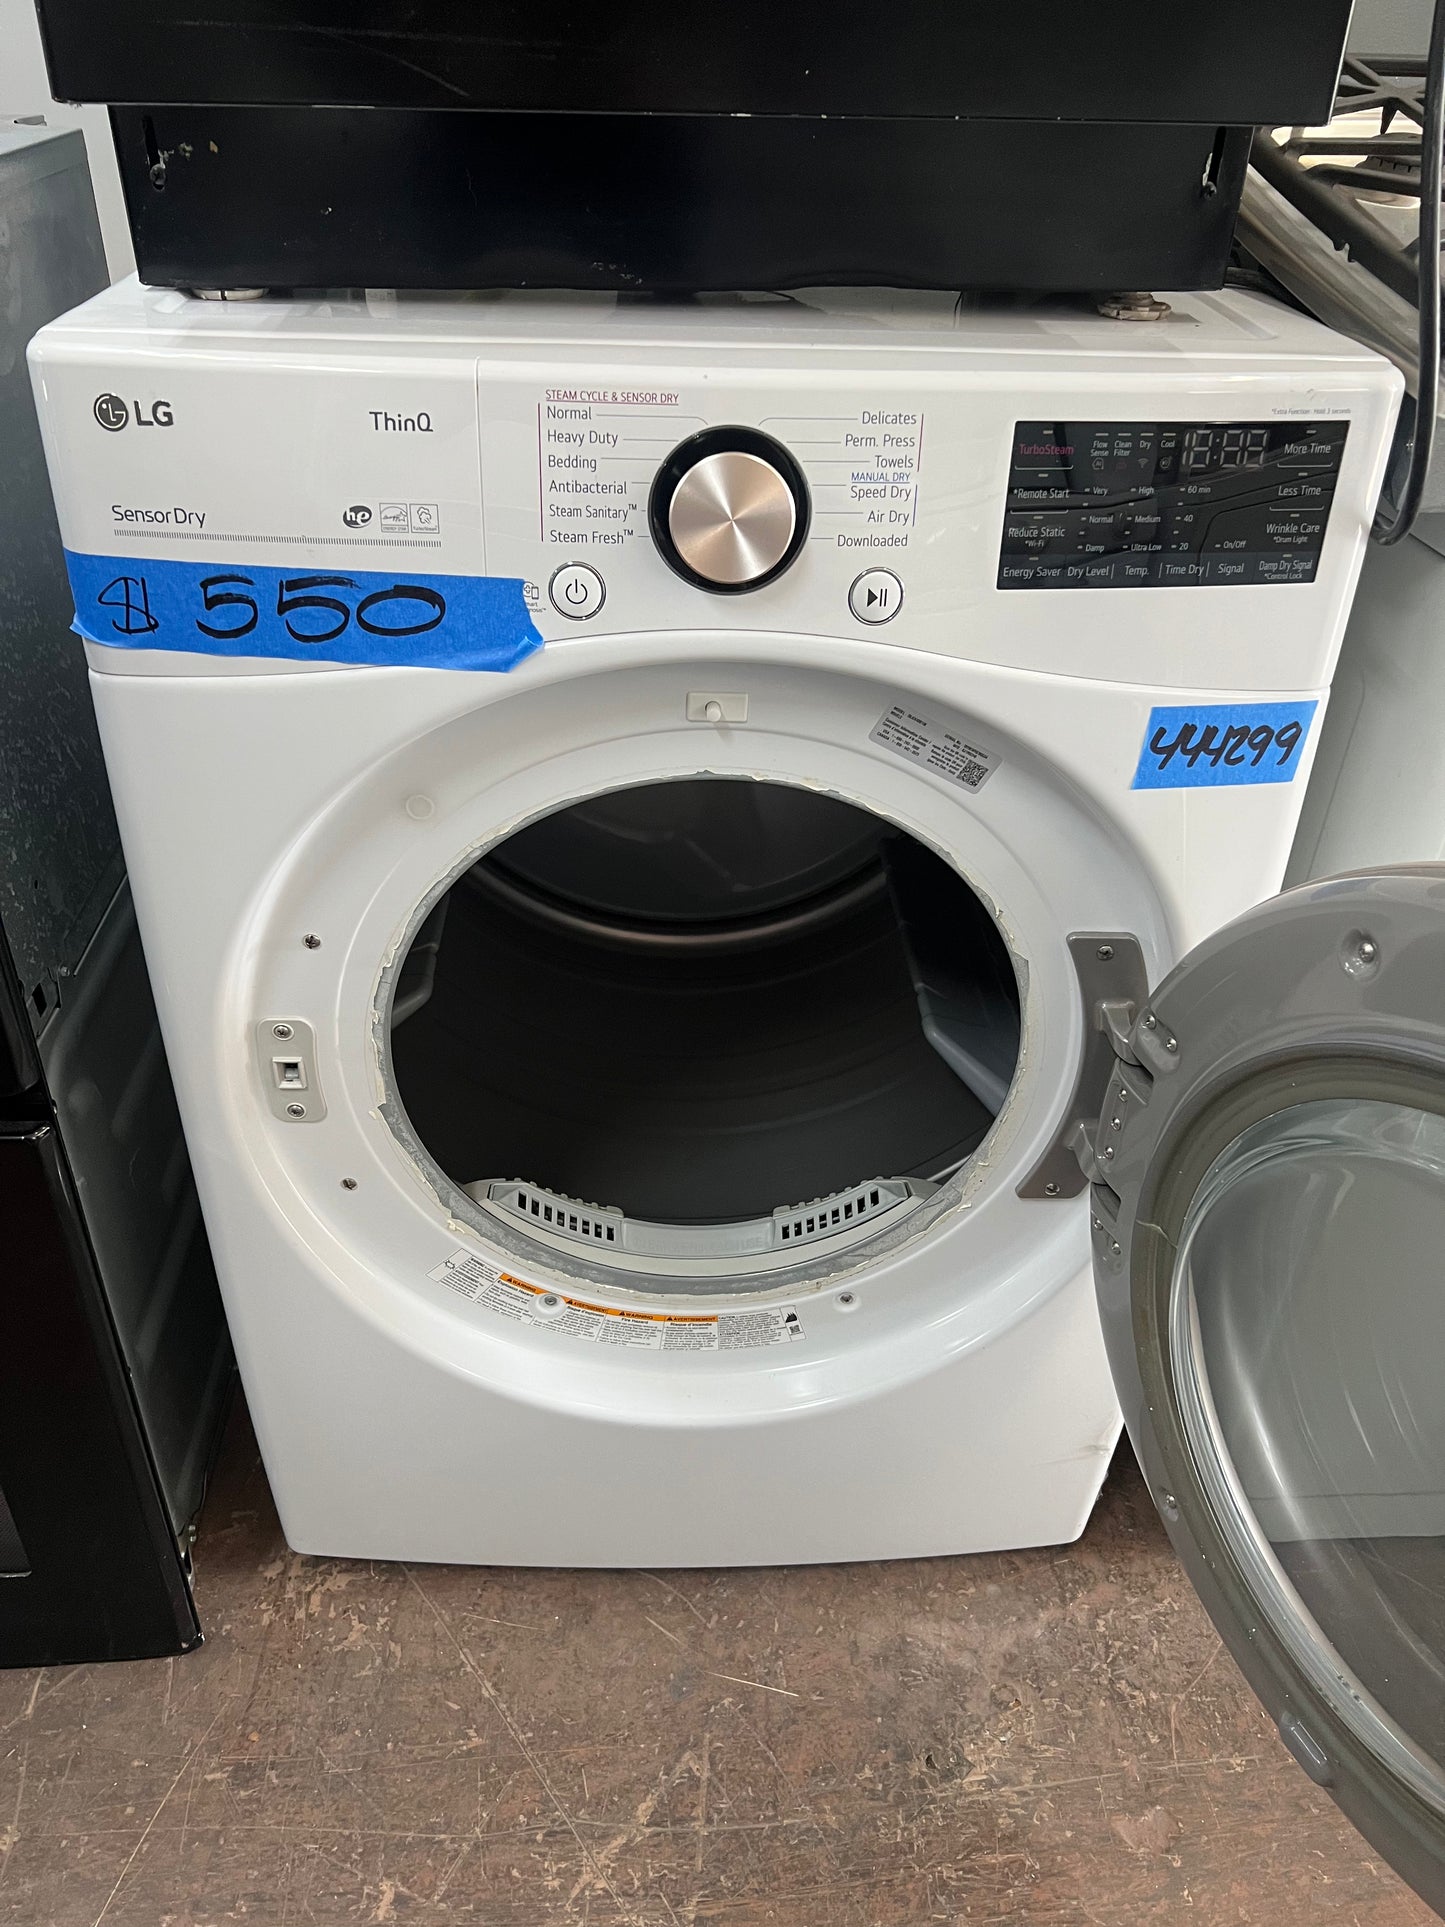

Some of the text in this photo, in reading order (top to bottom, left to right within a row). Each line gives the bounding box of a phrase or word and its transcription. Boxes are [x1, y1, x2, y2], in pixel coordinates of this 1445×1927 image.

[545, 389, 679, 404] STEAM CYCLE & SENSOR DRY
[133, 400, 174, 427] LG
[547, 405, 592, 420] Normal
[862, 411, 917, 425] Delicates
[369, 411, 434, 432] ThinQ
[547, 429, 619, 448] Heavy Duty
[845, 433, 916, 447] Perm. Press
[1019, 444, 1075, 455] TurboSteam
[1114, 440, 1132, 448] Clean
[1139, 441, 1151, 450] Dry
[1160, 440, 1176, 448] Cool
[1284, 443, 1331, 454] More Time
[1090, 449, 1109, 457] Sense
[548, 455, 597, 472] Bedding
[875, 454, 914, 468] Towels
[851, 472, 911, 482] MANUAL DRY
[549, 480, 627, 494] Antibacterial
[1093, 486, 1108, 496] Very
[1138, 486, 1154, 496] High
[1187, 486, 1211, 494] 60 min
[1278, 485, 1322, 496] Less Time
[850, 485, 912, 502] Speed Dry
[1050, 489, 1070, 498] Start
[549, 504, 582, 518] Steam
[867, 510, 910, 526] Air Dry
[1089, 515, 1114, 523] Normal
[1134, 515, 1161, 523] Medium
[1183, 514, 1194, 522] 40
[1008, 527, 1066, 537] Reduce Static
[1266, 523, 1320, 534] Wrinkle Care
[550, 530, 588, 543] Steam
[837, 534, 909, 547] Downloaded
[1292, 536, 1308, 544] Light
[1085, 544, 1105, 553] Damp
[1131, 543, 1162, 551] Ultra Low
[1223, 540, 1247, 549] On/Off
[1067, 566, 1109, 578] Dry Level
[1125, 565, 1150, 577] Temp.
[1165, 565, 1204, 577] Time Dry
[1217, 563, 1244, 575] Signal
[1259, 560, 1313, 572] Damp Dry Signal
[1003, 567, 1062, 579] Energy Saver
